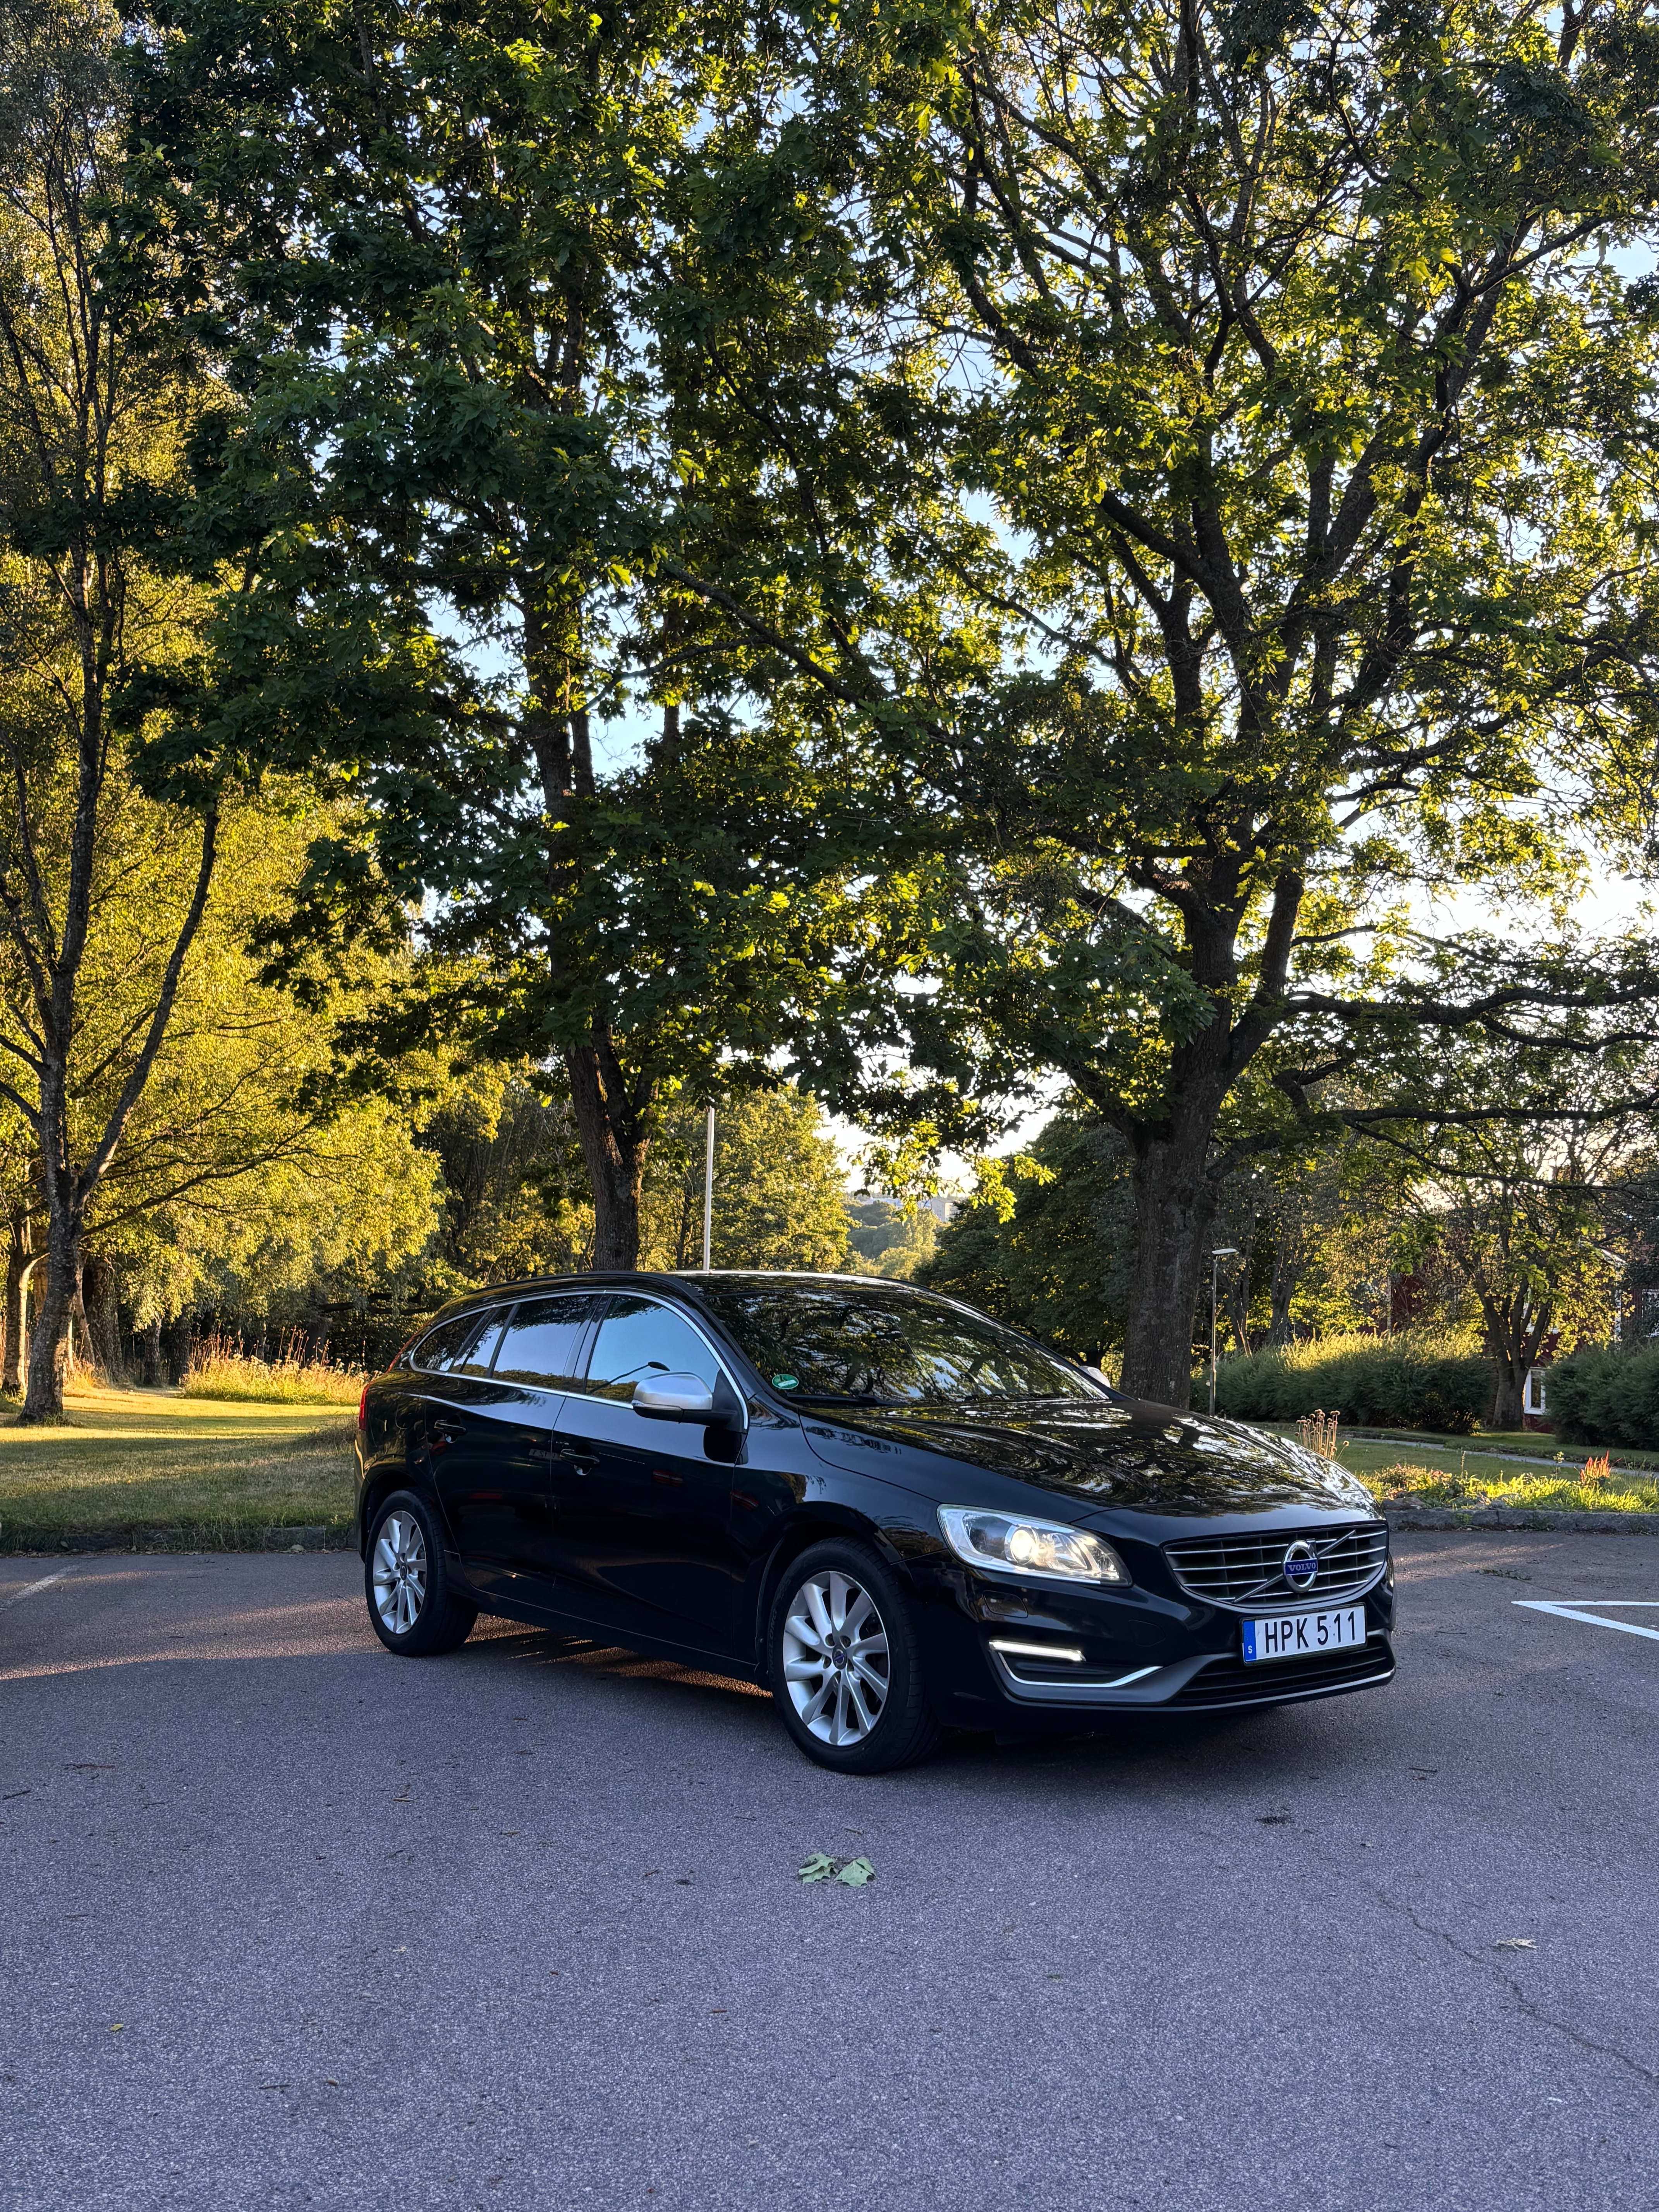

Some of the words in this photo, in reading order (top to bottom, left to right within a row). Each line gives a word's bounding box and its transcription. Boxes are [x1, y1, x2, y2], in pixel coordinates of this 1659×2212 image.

[1287, 1562, 1316, 1572] VOLVO
[1264, 1617, 1309, 1654] HPK
[1317, 1611, 1355, 1645] 511
[1248, 1645, 1253, 1654] S
